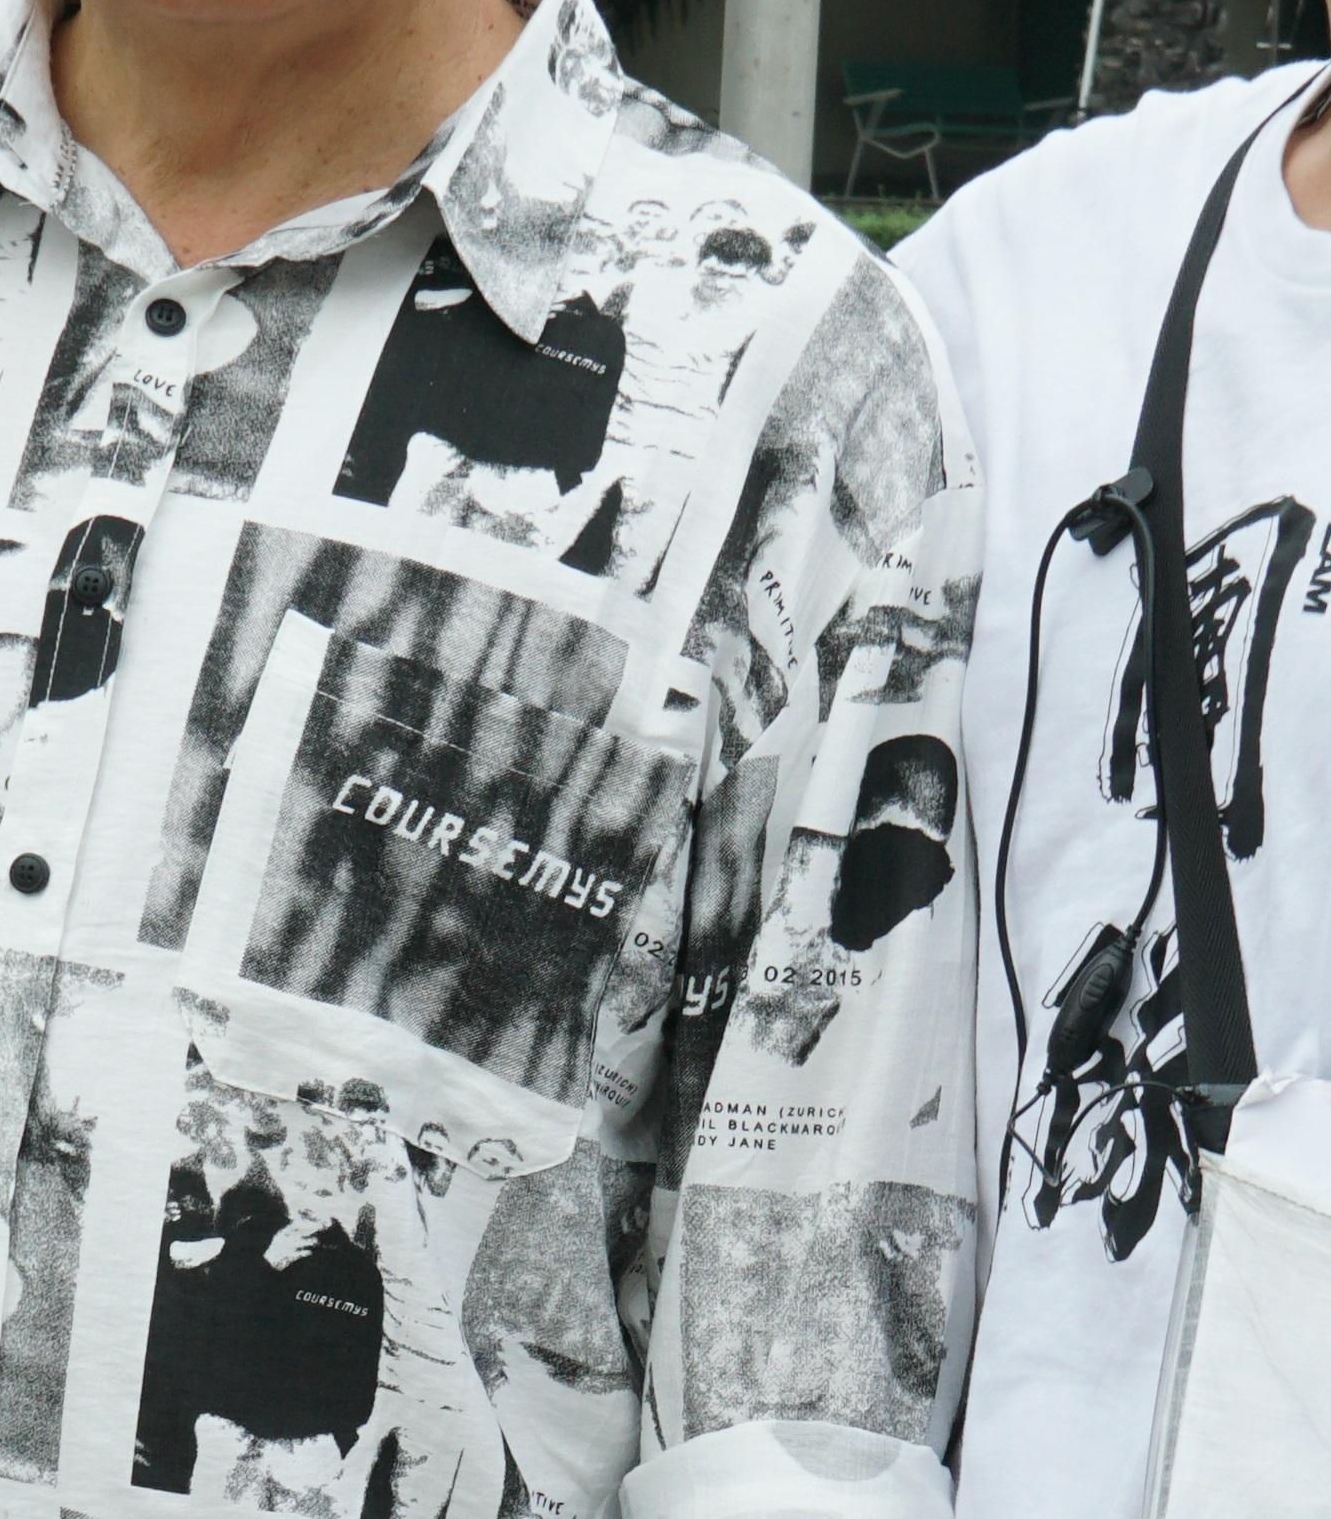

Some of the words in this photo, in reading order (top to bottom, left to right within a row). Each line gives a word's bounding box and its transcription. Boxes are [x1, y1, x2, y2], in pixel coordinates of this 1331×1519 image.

[133, 368, 177, 397] LOVE
[331, 773, 623, 919] COURSEMYS
[764, 965, 797, 984] 02
[810, 968, 863, 987] 2015
[703, 1102, 767, 1116] ADMAN
[693, 1135, 718, 1147] DY
[727, 1137, 777, 1151] JANE
